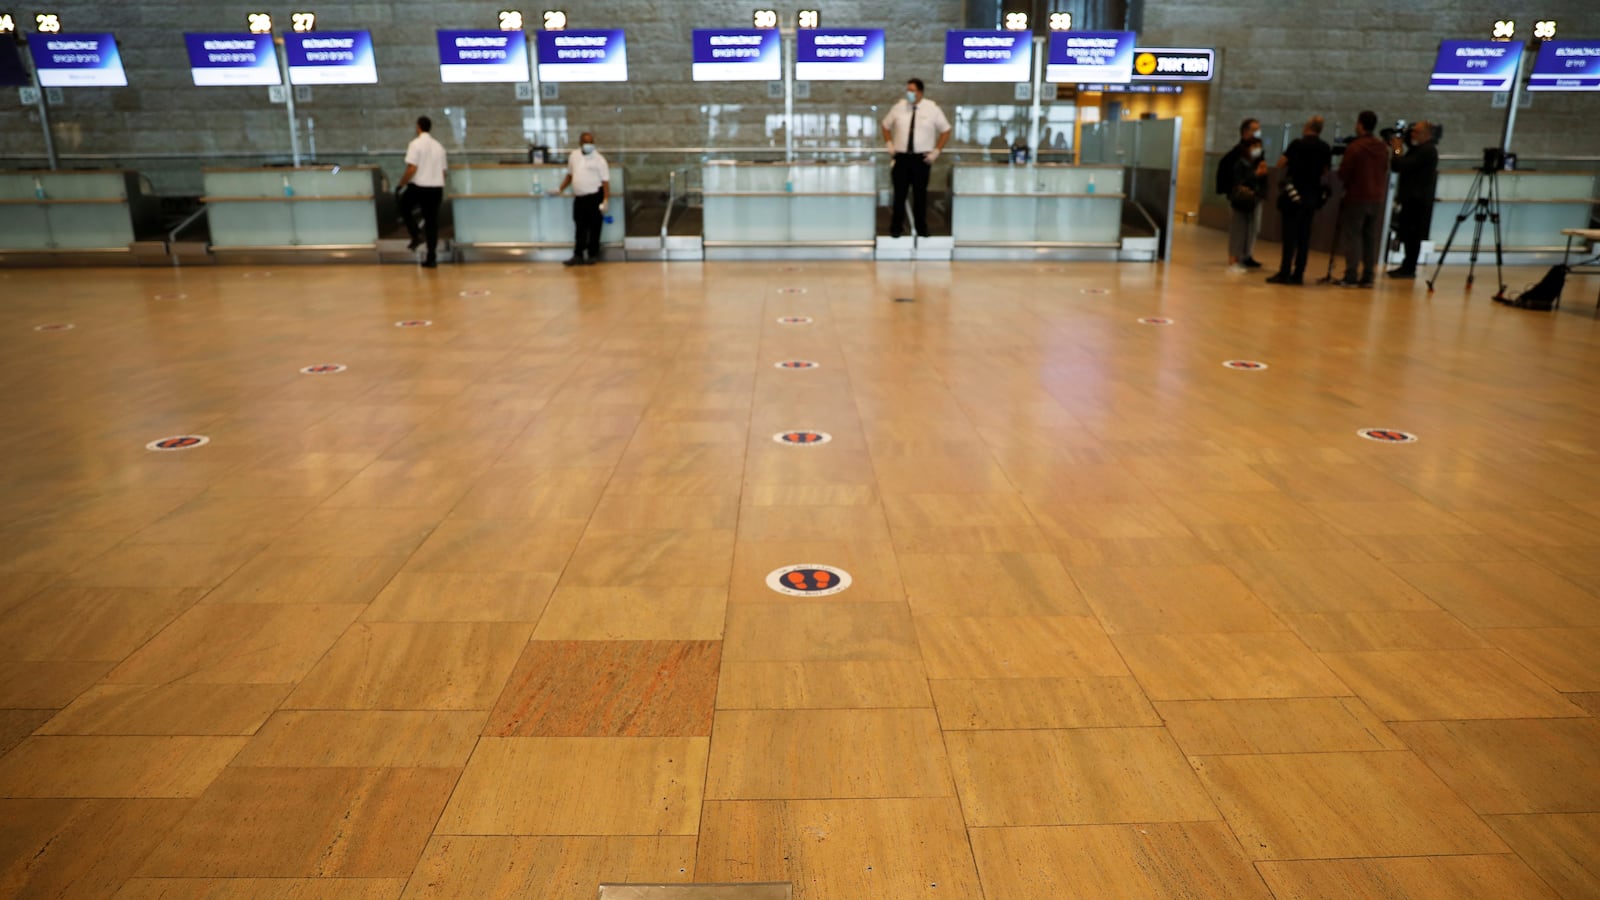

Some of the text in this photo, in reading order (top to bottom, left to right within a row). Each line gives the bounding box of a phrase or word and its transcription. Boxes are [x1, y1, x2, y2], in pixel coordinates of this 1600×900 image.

[0, 14, 14, 32] 4
[36, 14, 60, 32] 25
[291, 13, 314, 32] 27
[499, 11, 522, 30] 28
[754, 10, 777, 28] 30
[799, 10, 818, 28] 31
[1006, 12, 1028, 30] 32
[1050, 12, 1071, 30] 33
[1493, 20, 1514, 38] 34
[1534, 20, 1556, 38] 35
